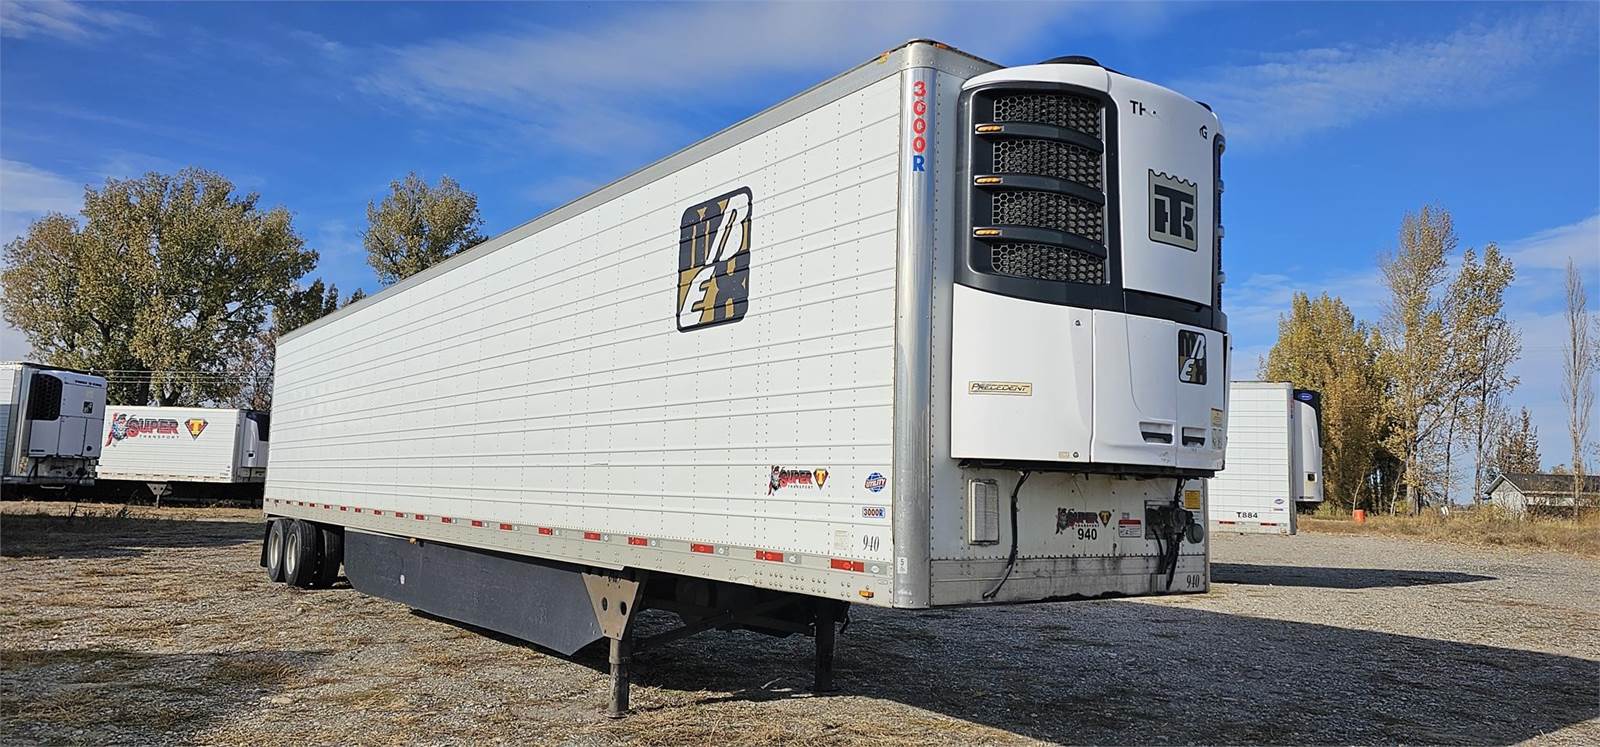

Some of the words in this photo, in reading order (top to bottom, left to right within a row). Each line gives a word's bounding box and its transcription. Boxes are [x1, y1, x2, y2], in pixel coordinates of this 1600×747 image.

[912, 80, 926, 172] 3000R
[972, 382, 1030, 392] PRECEDENT
[127, 414, 179, 437] SUPER
[779, 466, 812, 488] SUPER
[864, 508, 884, 517] 3000R
[1077, 528, 1098, 540] 940
[862, 534, 880, 552] 940
[1186, 574, 1200, 588] 940
